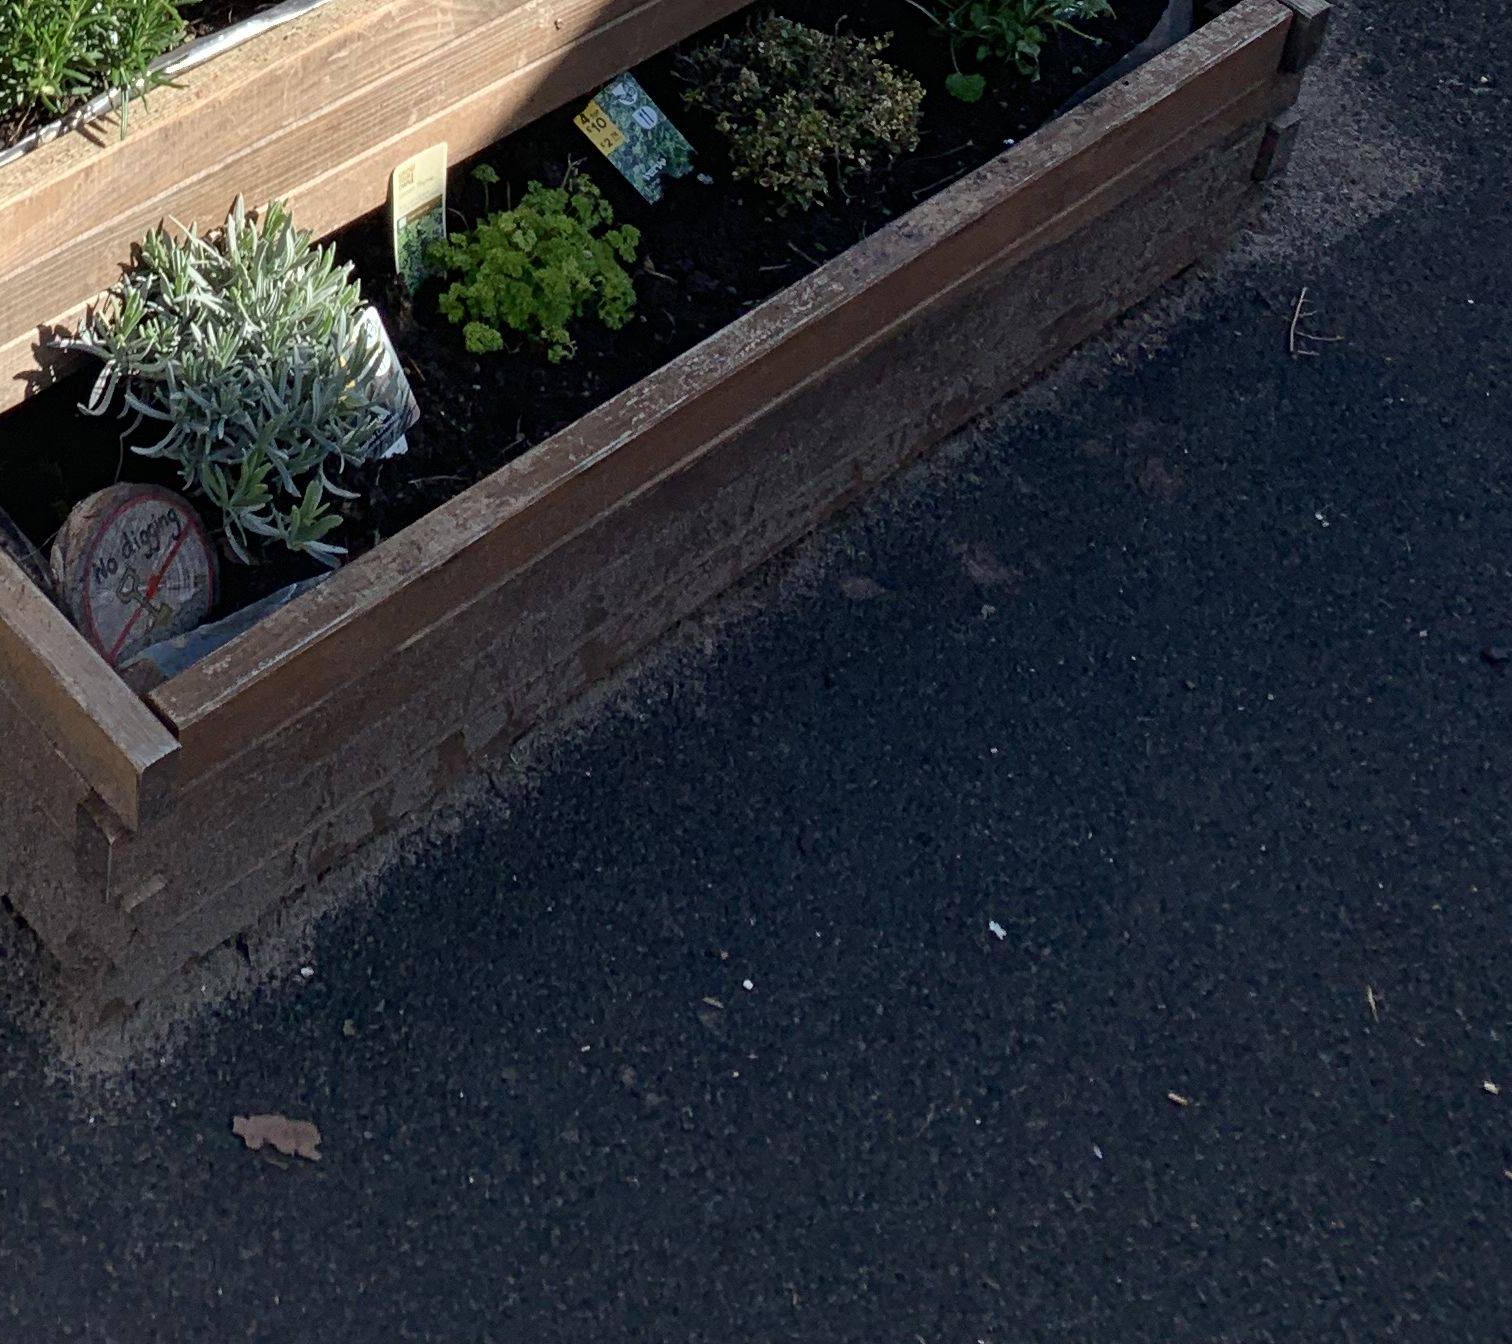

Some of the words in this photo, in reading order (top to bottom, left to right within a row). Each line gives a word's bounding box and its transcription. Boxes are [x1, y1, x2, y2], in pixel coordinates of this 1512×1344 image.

[579, 113, 590, 125] 4
[94, 557, 118, 583] No
[121, 507, 182, 559] digging
